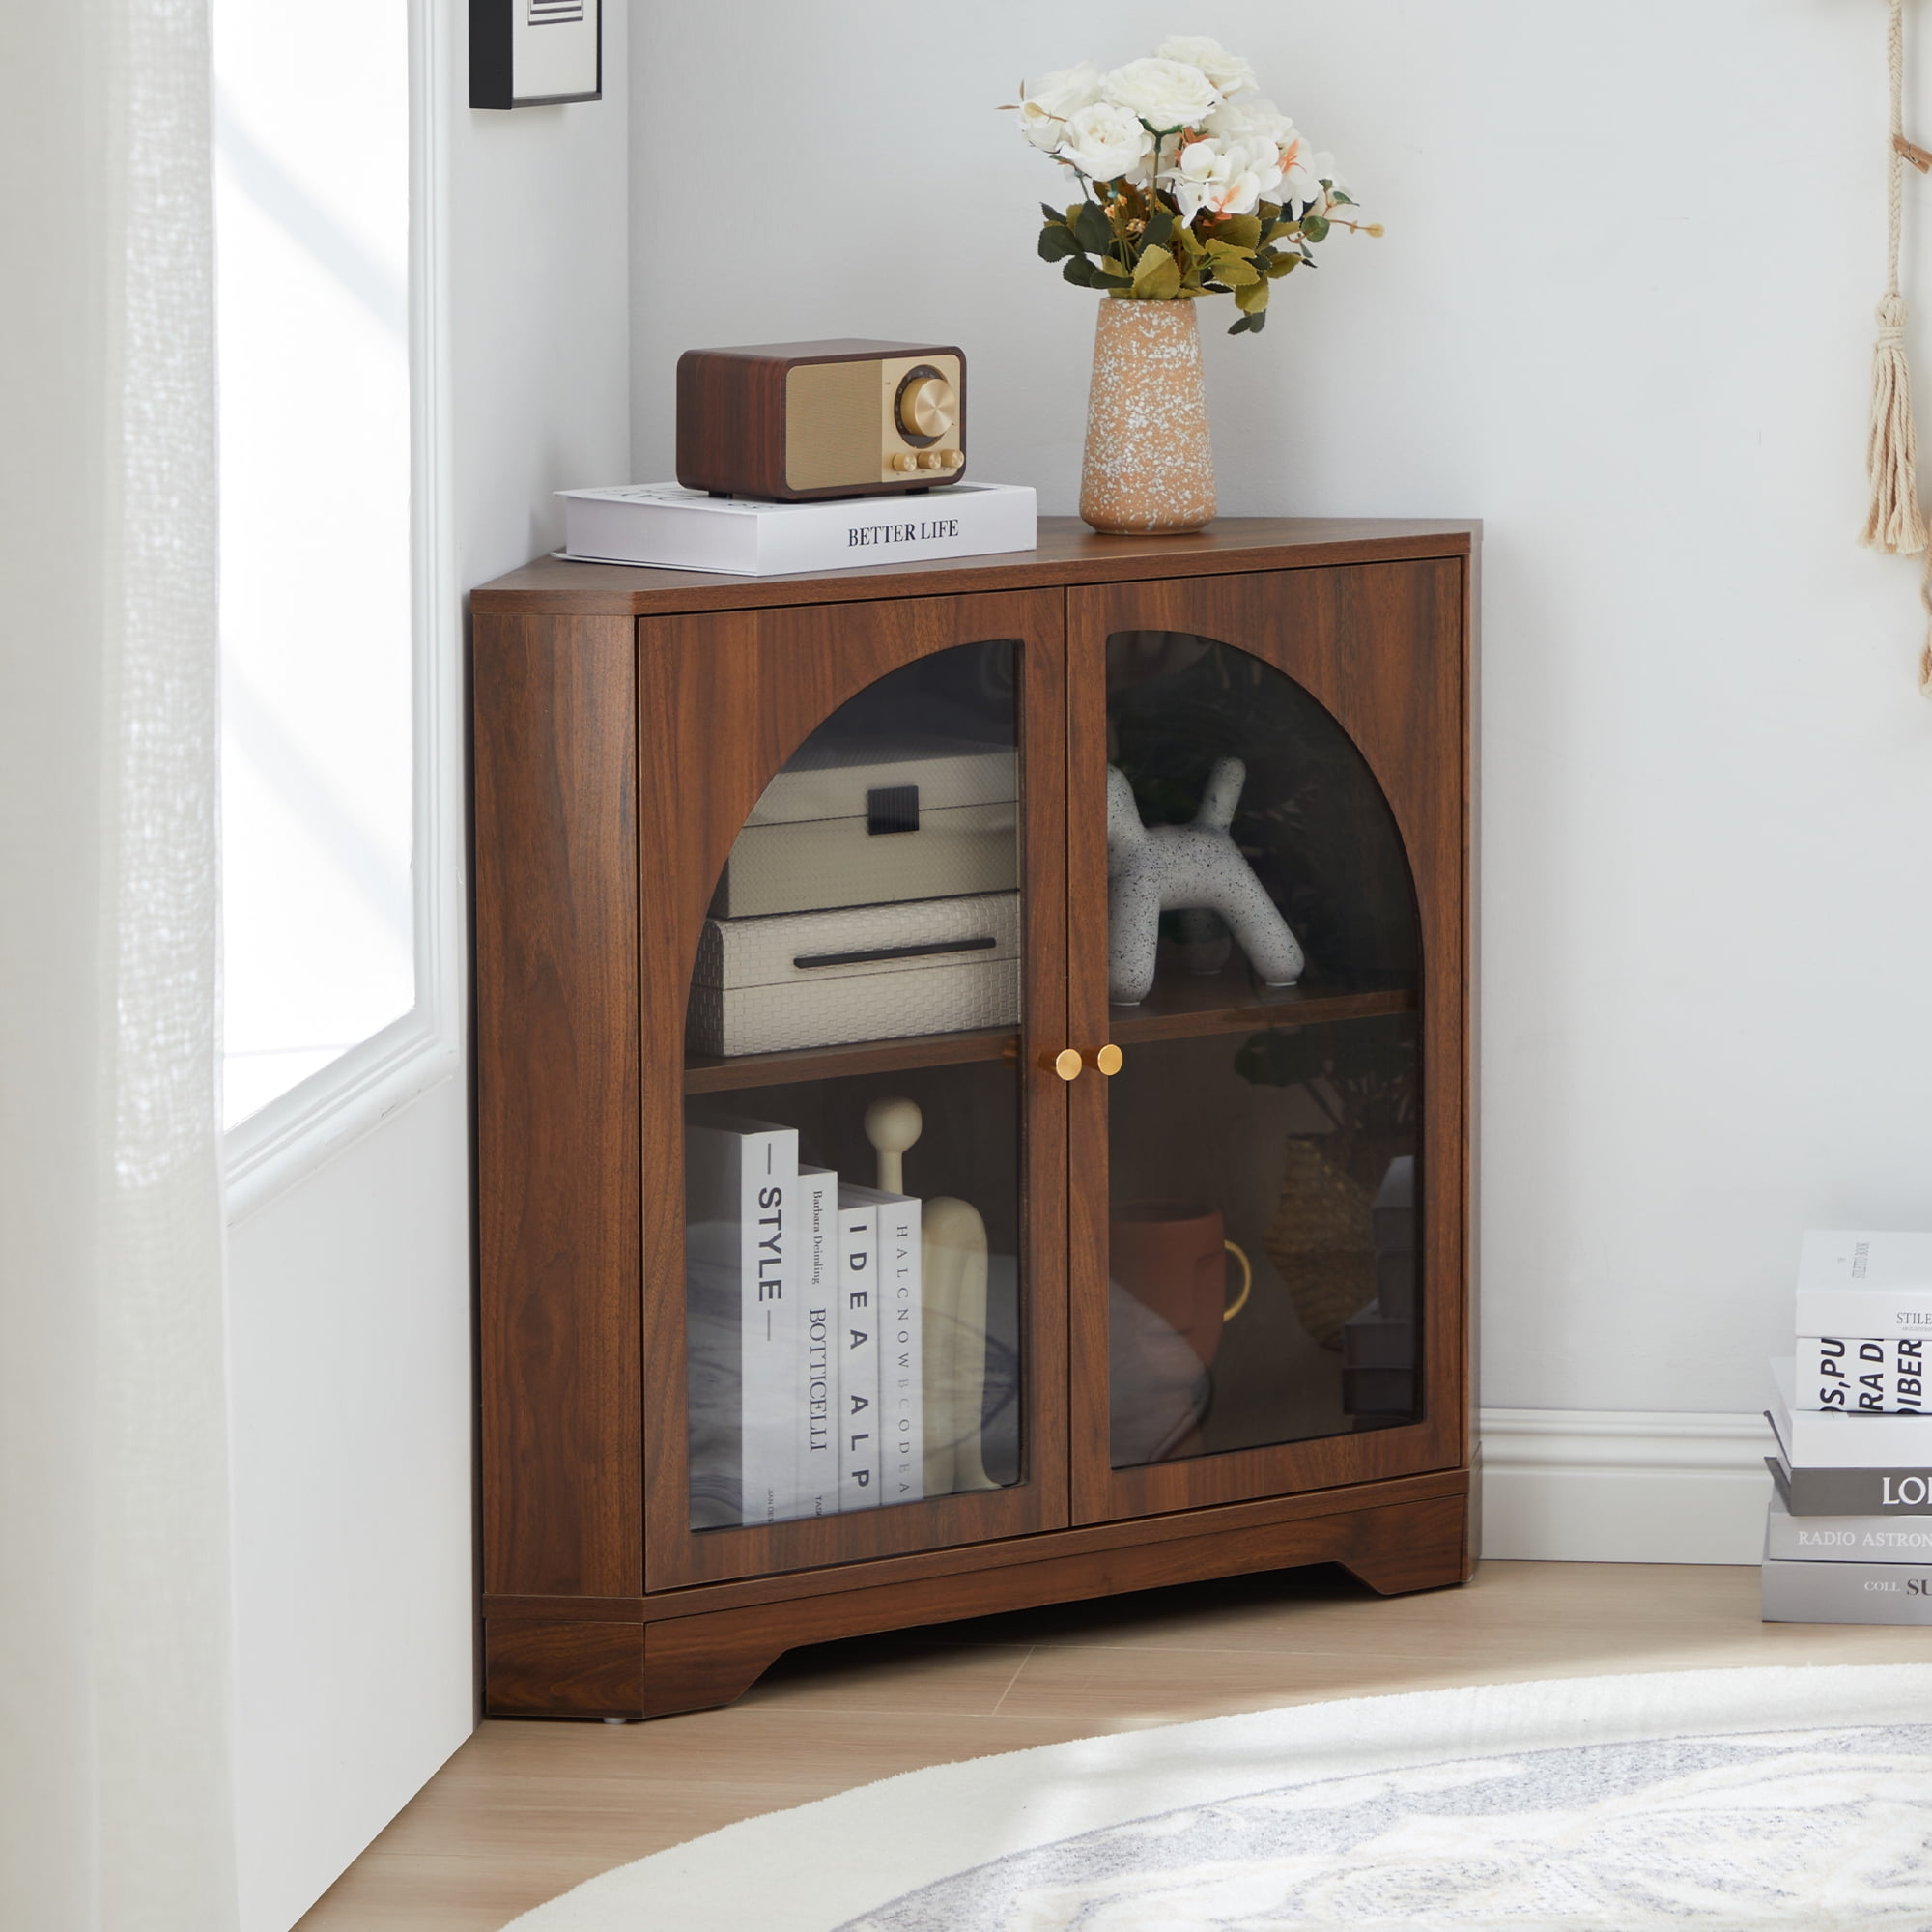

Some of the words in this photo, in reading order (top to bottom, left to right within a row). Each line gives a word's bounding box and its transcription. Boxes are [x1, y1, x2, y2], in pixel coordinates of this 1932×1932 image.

[848, 523, 916, 547] BETTER
[921, 519, 959, 540] LIFE
[758, 1187, 782, 1302] STYLE
[813, 1190, 823, 1233] Barbara
[811, 1236, 823, 1285] Deimling
[849, 1225, 868, 1350] IDEA
[810, 1308, 828, 1454] BOTTICELLI
[1896, 1339, 1922, 1410] IBER
[851, 1395, 870, 1488] ALP
[1798, 1531, 1856, 1546] RADIO
